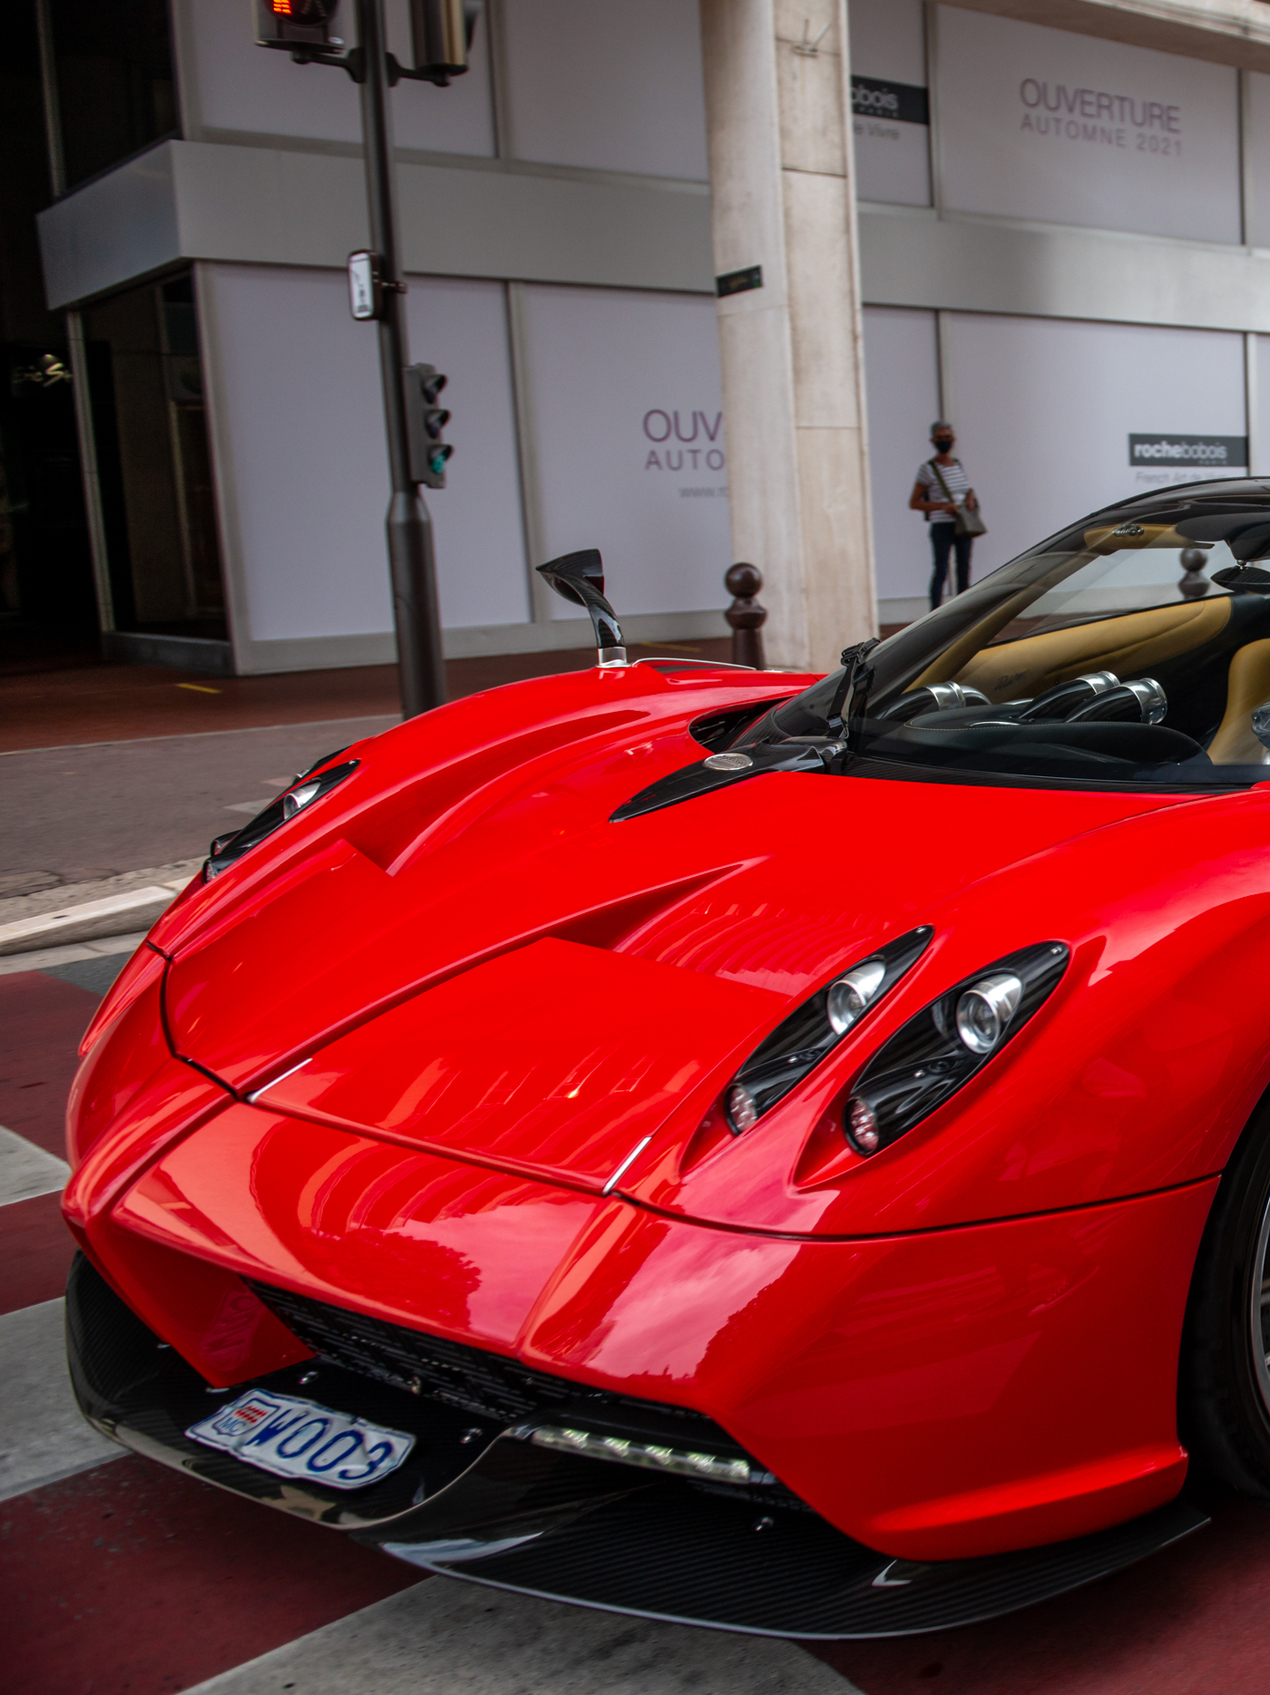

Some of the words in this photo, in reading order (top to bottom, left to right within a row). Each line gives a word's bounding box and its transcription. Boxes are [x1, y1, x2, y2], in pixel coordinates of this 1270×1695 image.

[1020, 78, 1181, 134] OUVERTURE
[1021, 113, 1126, 148] AUTOMNE
[1136, 132, 1182, 156] 2021
[643, 409, 723, 442] OUV
[644, 449, 725, 471] AUTO
[1133, 441, 1228, 459] rochebobois
[218, 1417, 247, 1434] MC
[245, 1408, 394, 1480] W003
